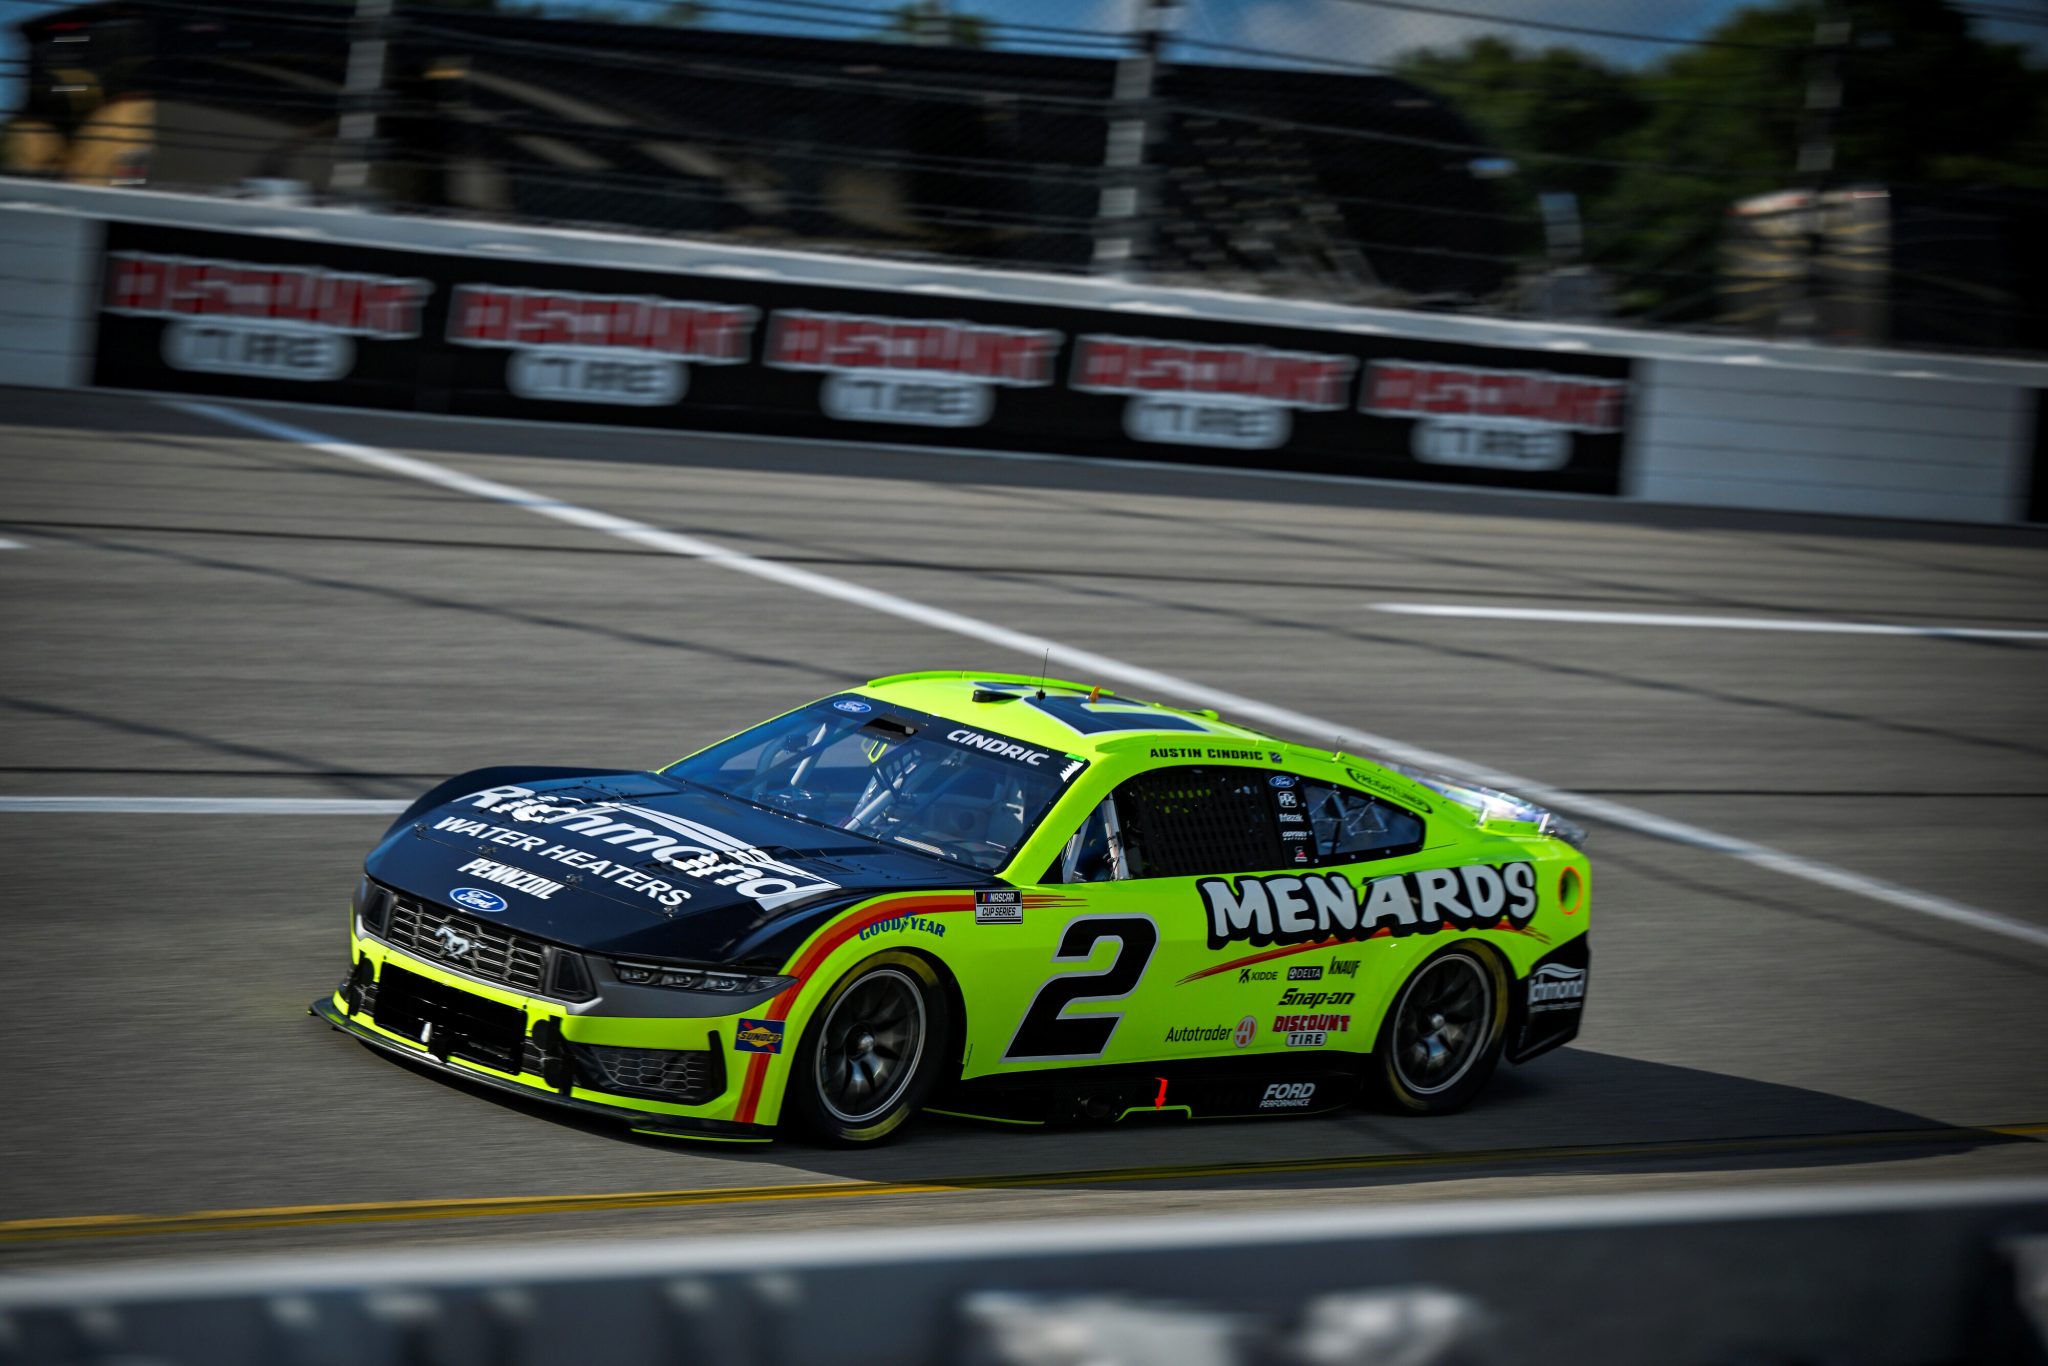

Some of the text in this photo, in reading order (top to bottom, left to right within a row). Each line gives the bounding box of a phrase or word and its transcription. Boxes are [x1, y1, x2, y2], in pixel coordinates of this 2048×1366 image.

[947, 729, 1049, 766] CINDRIC
[1150, 748, 1263, 760] AUSTIN CINDRIC
[433, 816, 694, 907] WATER HEATERS
[456, 858, 565, 900] PENNZOIL
[453, 888, 504, 911] Ford
[989, 893, 1015, 903] NASCAR
[1199, 861, 1537, 949] MENARDS
[982, 907, 1017, 917] CUP SERIES
[1250, 971, 1279, 981] KIDDE
[1295, 968, 1322, 979] DELTA
[1002, 913, 1160, 1062] 2
[1278, 988, 1356, 1009] Snap-on
[1272, 1014, 1351, 1033] DISCOUNT
[738, 1031, 782, 1043] SUNOCO
[1165, 1025, 1233, 1043] Autotrader
[1289, 1033, 1324, 1046] TIRE
[1263, 1083, 1316, 1100] FORD
